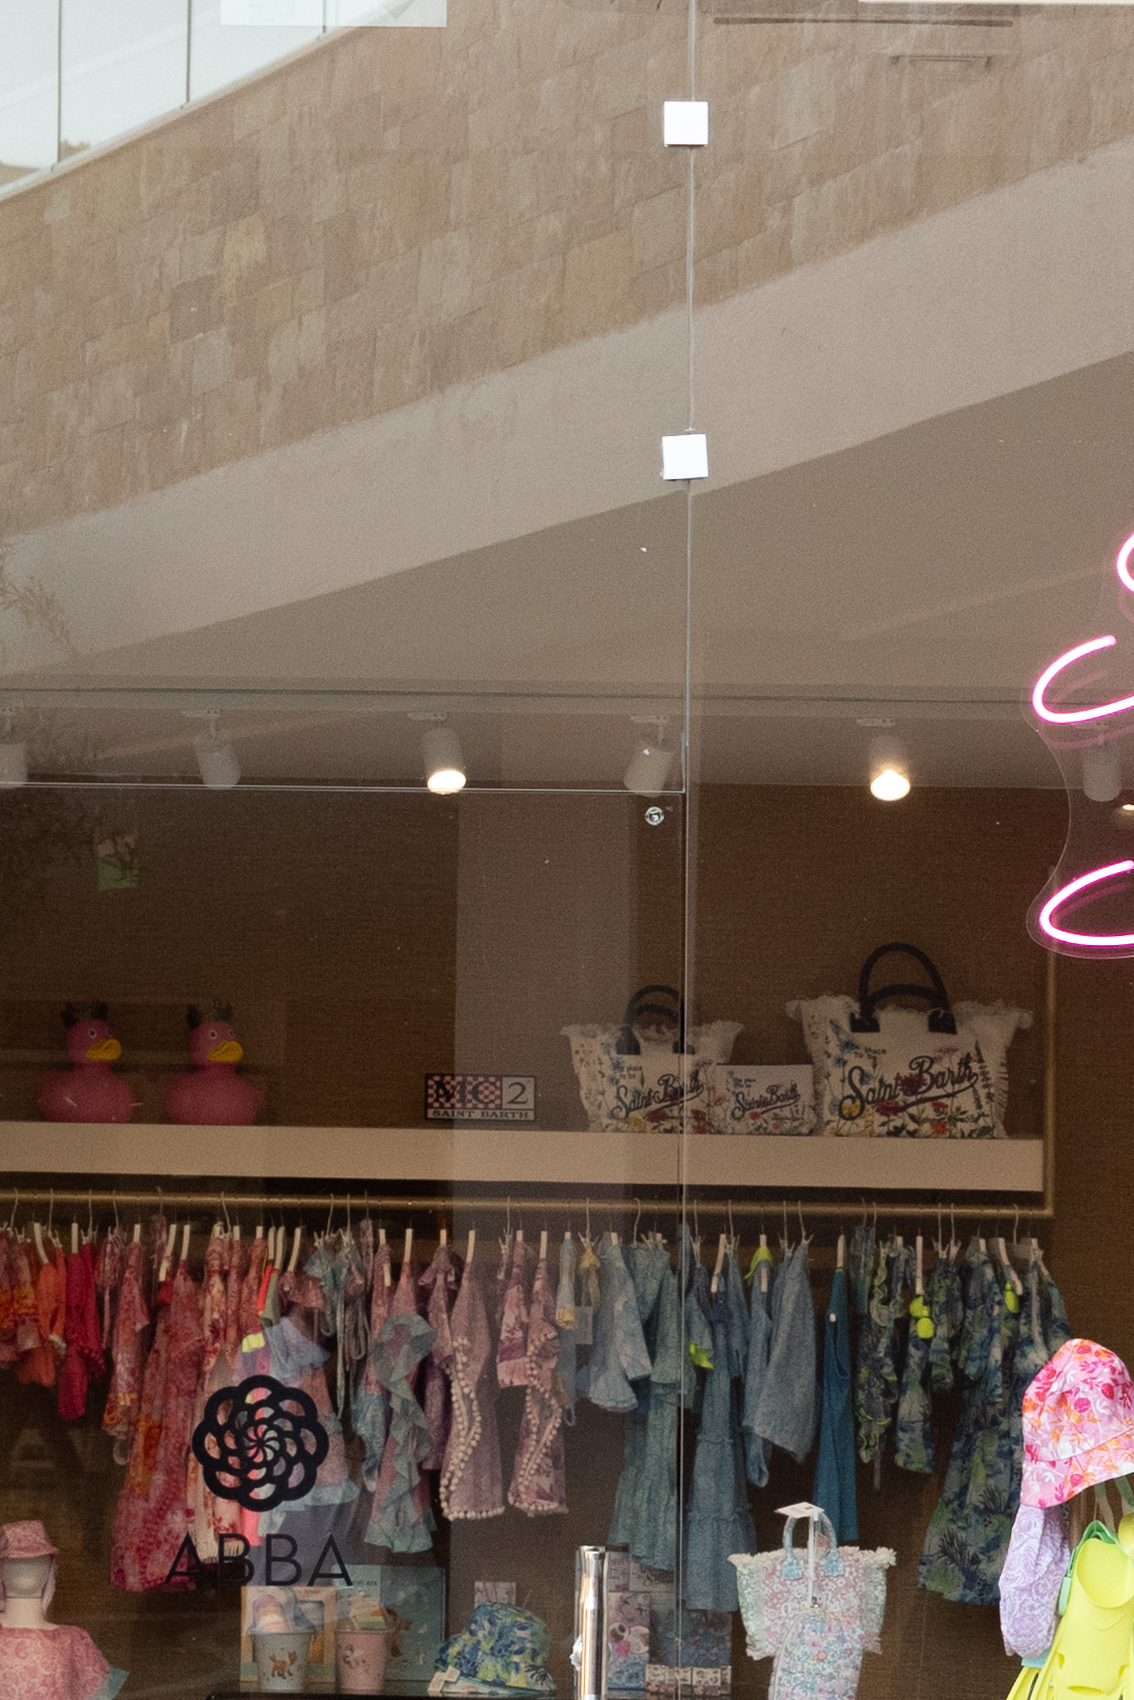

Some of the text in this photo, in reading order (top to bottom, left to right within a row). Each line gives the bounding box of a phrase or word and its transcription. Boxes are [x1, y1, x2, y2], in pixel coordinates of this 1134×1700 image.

[432, 1108, 529, 1119] SAINT BARTH
[838, 1051, 979, 1121] Saint Barth
[164, 1532, 354, 1587] ABBA
